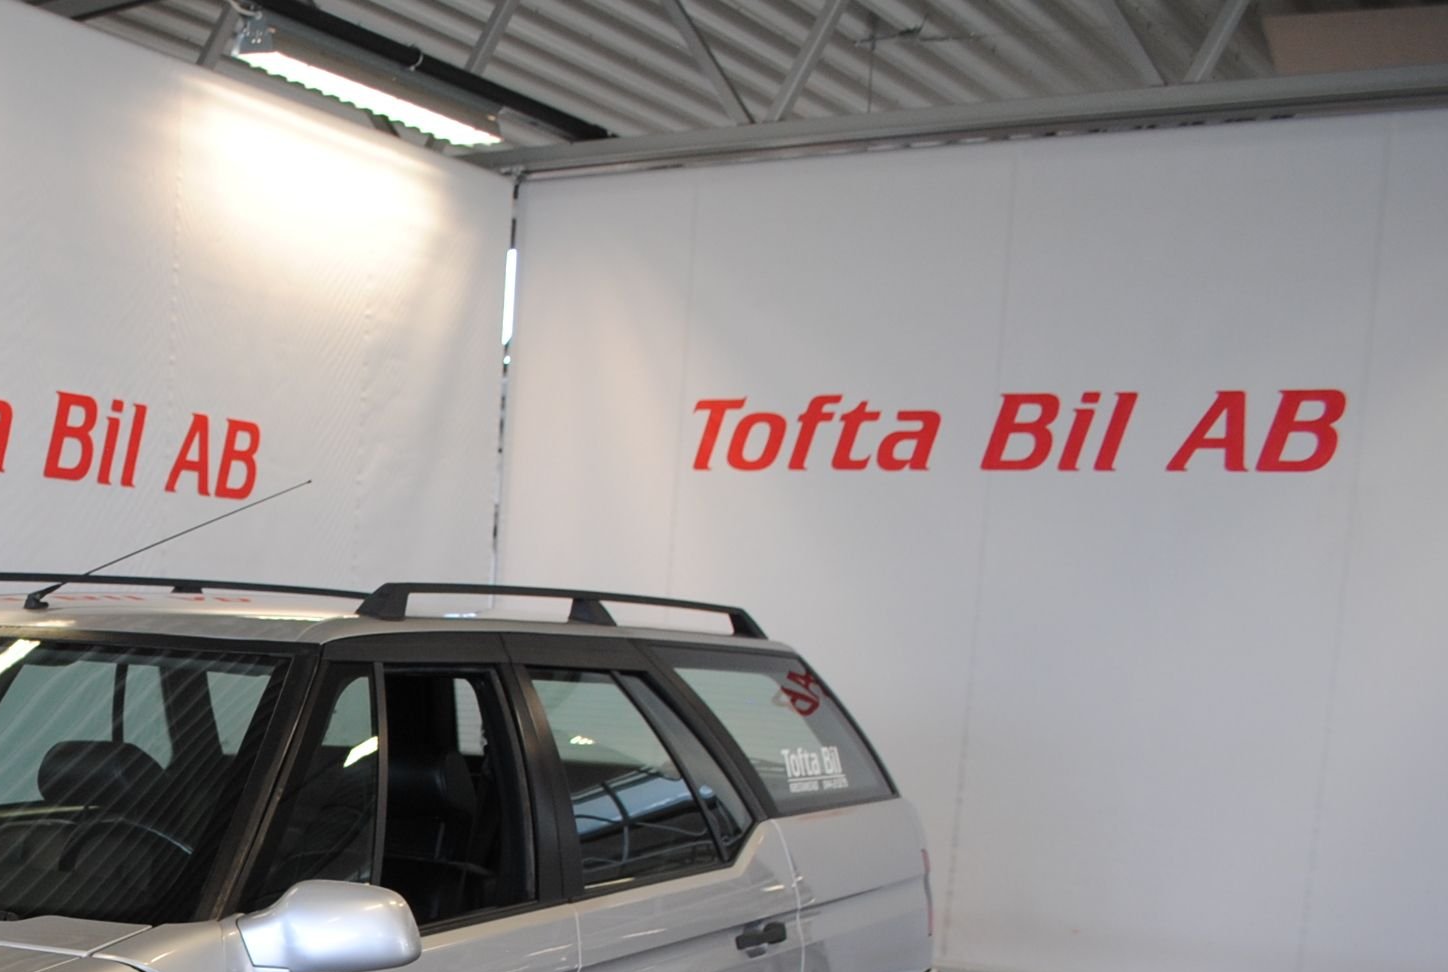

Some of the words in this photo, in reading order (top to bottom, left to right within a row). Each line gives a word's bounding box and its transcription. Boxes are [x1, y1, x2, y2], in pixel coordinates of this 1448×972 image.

[43, 390, 149, 489] Bil
[164, 411, 262, 501] AB
[691, 393, 942, 473] Tofta
[979, 390, 1139, 473] Bil
[1165, 388, 1348, 473] AB
[780, 747, 822, 779] Tofta
[819, 745, 843, 775] Bil
